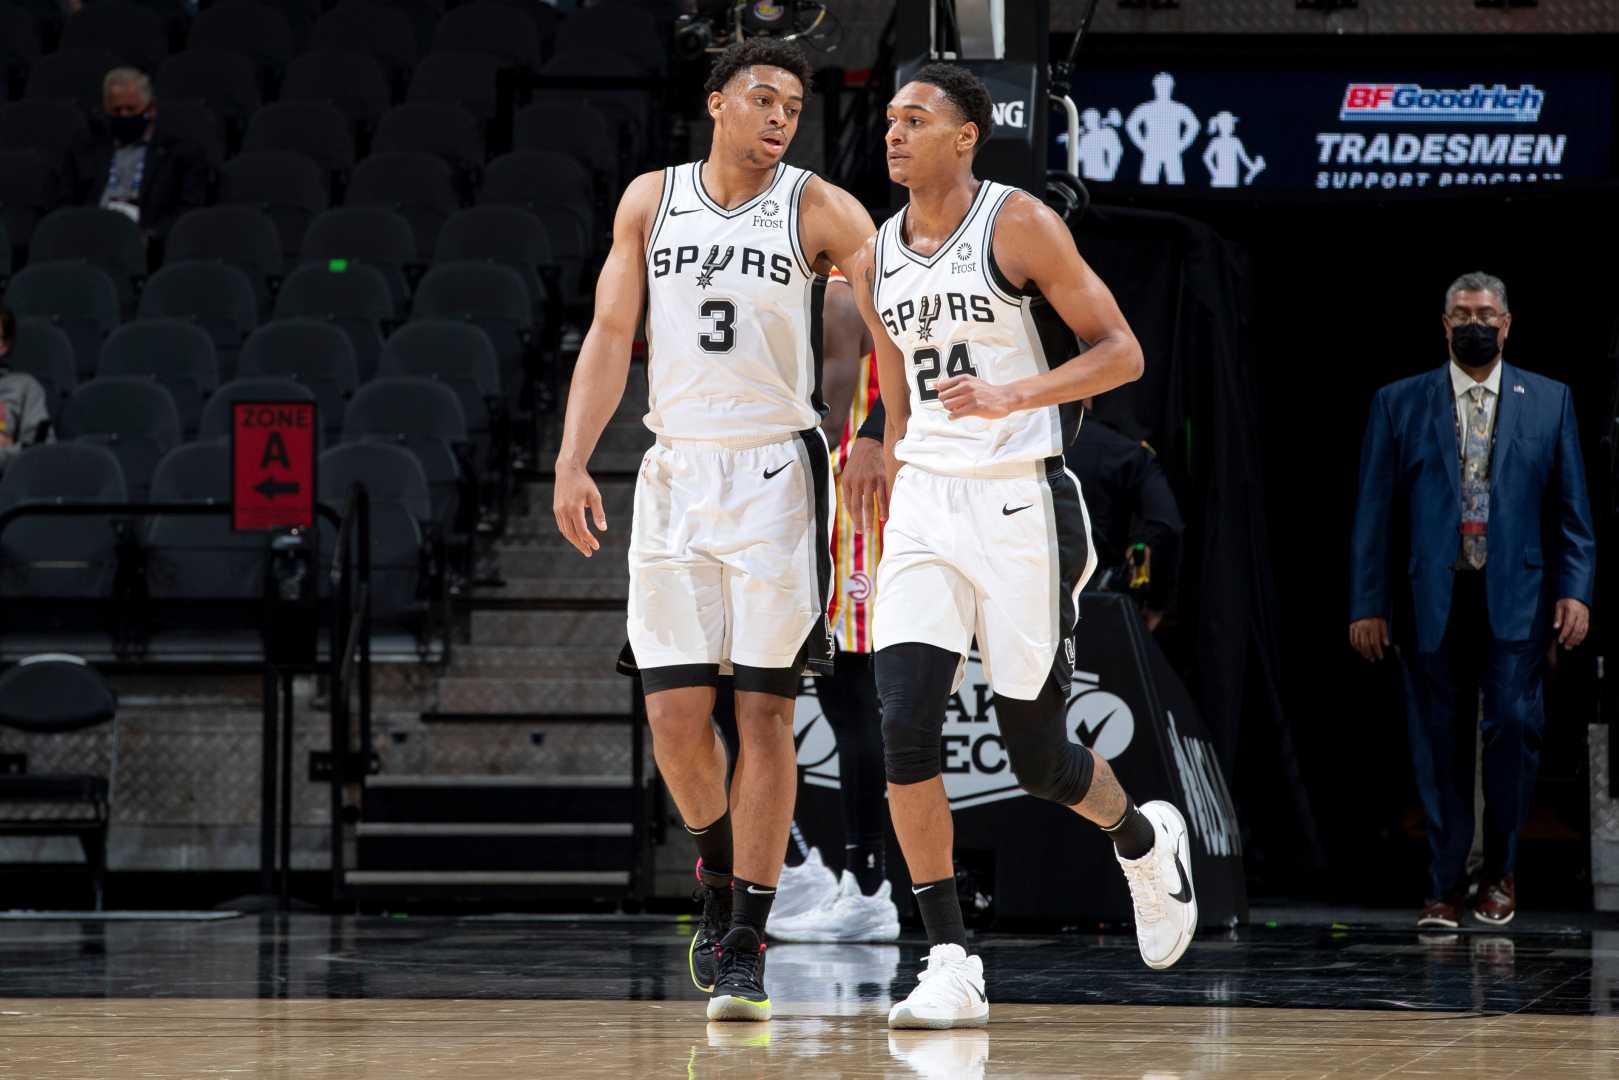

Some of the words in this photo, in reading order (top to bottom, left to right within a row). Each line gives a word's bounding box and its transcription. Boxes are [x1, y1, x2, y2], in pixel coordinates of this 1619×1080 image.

[1345, 84, 1543, 111] BFGoodrich
[1316, 133, 1567, 165] TRADESMEN
[1315, 171, 1431, 189] SUPPORT
[752, 215, 784, 229] Frost
[653, 245, 792, 290] SPURS
[951, 262, 977, 275] Frost
[698, 298, 737, 354] 3
[881, 293, 995, 343] SPURS
[913, 339, 979, 404] 24
[243, 407, 310, 429] ZONE
[260, 431, 291, 469] A
